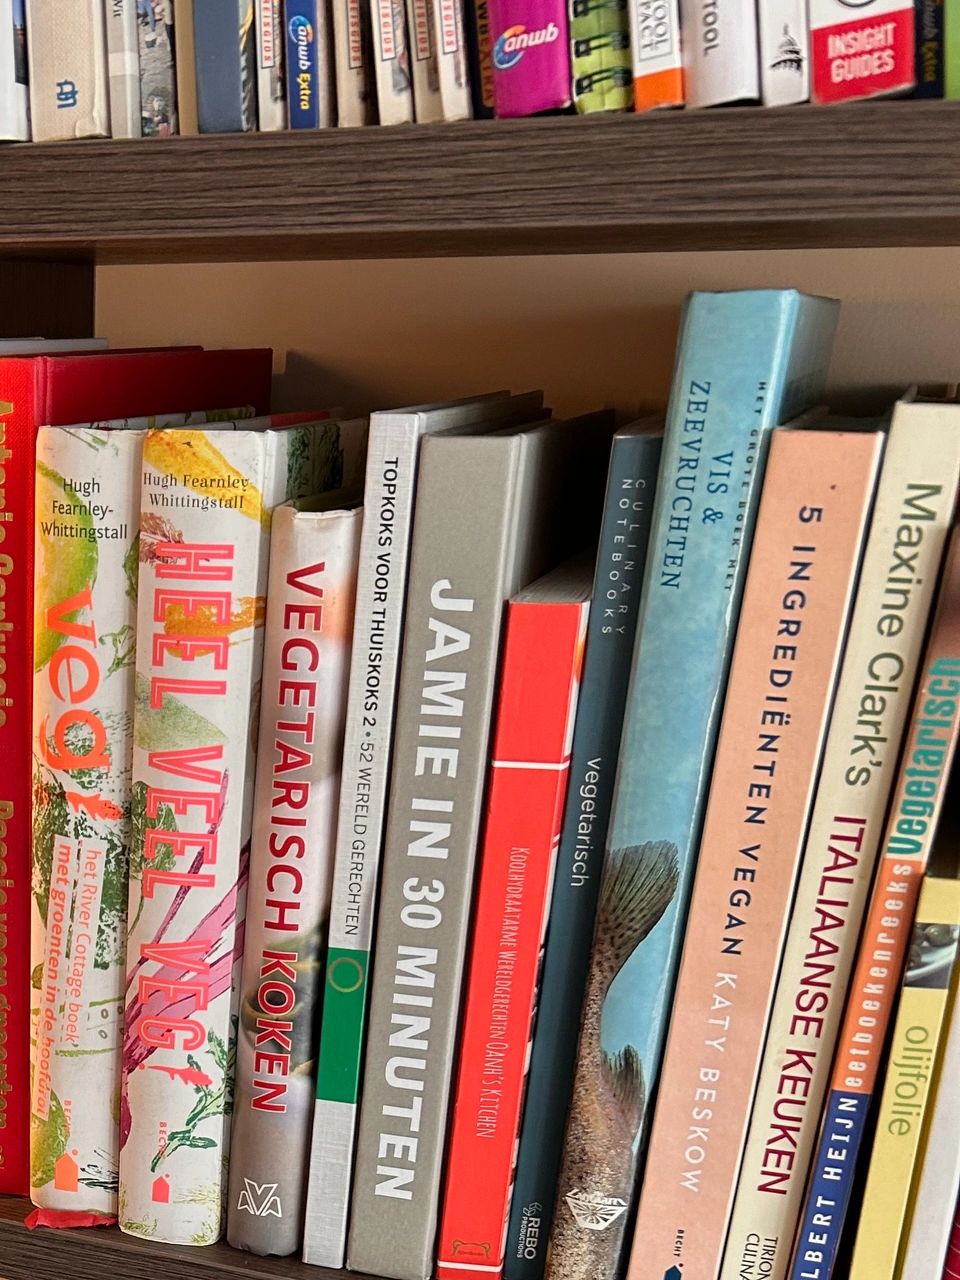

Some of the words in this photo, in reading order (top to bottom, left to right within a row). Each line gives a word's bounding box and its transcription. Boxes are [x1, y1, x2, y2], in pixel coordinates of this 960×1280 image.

[504, 22, 559, 52] anwb
[828, 22, 897, 58] INSIGHT
[831, 50, 895, 83] GUIDES
[52, 500, 114, 521] Fearnley-
[63, 477, 100, 497] Hugh
[143, 473, 177, 490] Hugh
[149, 493, 244, 511] Whittingstall
[378, 457, 398, 546] TOPKOKS
[660, 381, 711, 589] ZEEVRUCHTEN
[708, 451, 734, 494] VIS
[799, 506, 823, 523] 5
[41, 522, 127, 543] Whittingstall
[373, 552, 391, 603] VOOR
[601, 479, 633, 635] NOTEBOOKS
[616, 479, 646, 635] CULINARY
[877, 483, 943, 637] Maxine
[149, 542, 235, 710] HEEL
[365, 608, 385, 711] THUISKOKS
[414, 579, 474, 778] JAMIE
[745, 545, 816, 825] INGREDIËNTEN
[844, 652, 904, 786] Clark's
[264, 561, 326, 933] VEGETARISCH
[142, 744, 224, 899] VEEL
[353, 767, 371, 835] WERELD
[407, 798, 454, 859] IN
[570, 757, 602, 888] vegetarisch
[344, 839, 365, 936] GERECHTEN
[400, 877, 445, 929] 30
[723, 844, 762, 956] VEGAN
[790, 816, 868, 1037] ITALIAANSE
[251, 950, 298, 1113] KOKEN
[705, 972, 737, 1053] KATY
[375, 945, 438, 1201] MINUTEN
[758, 1048, 816, 1195] KEUKEN
[888, 1026, 932, 1136] olijfolie
[679, 1067, 720, 1192] BESKOW
[823, 1098, 858, 1181] HEIJN
